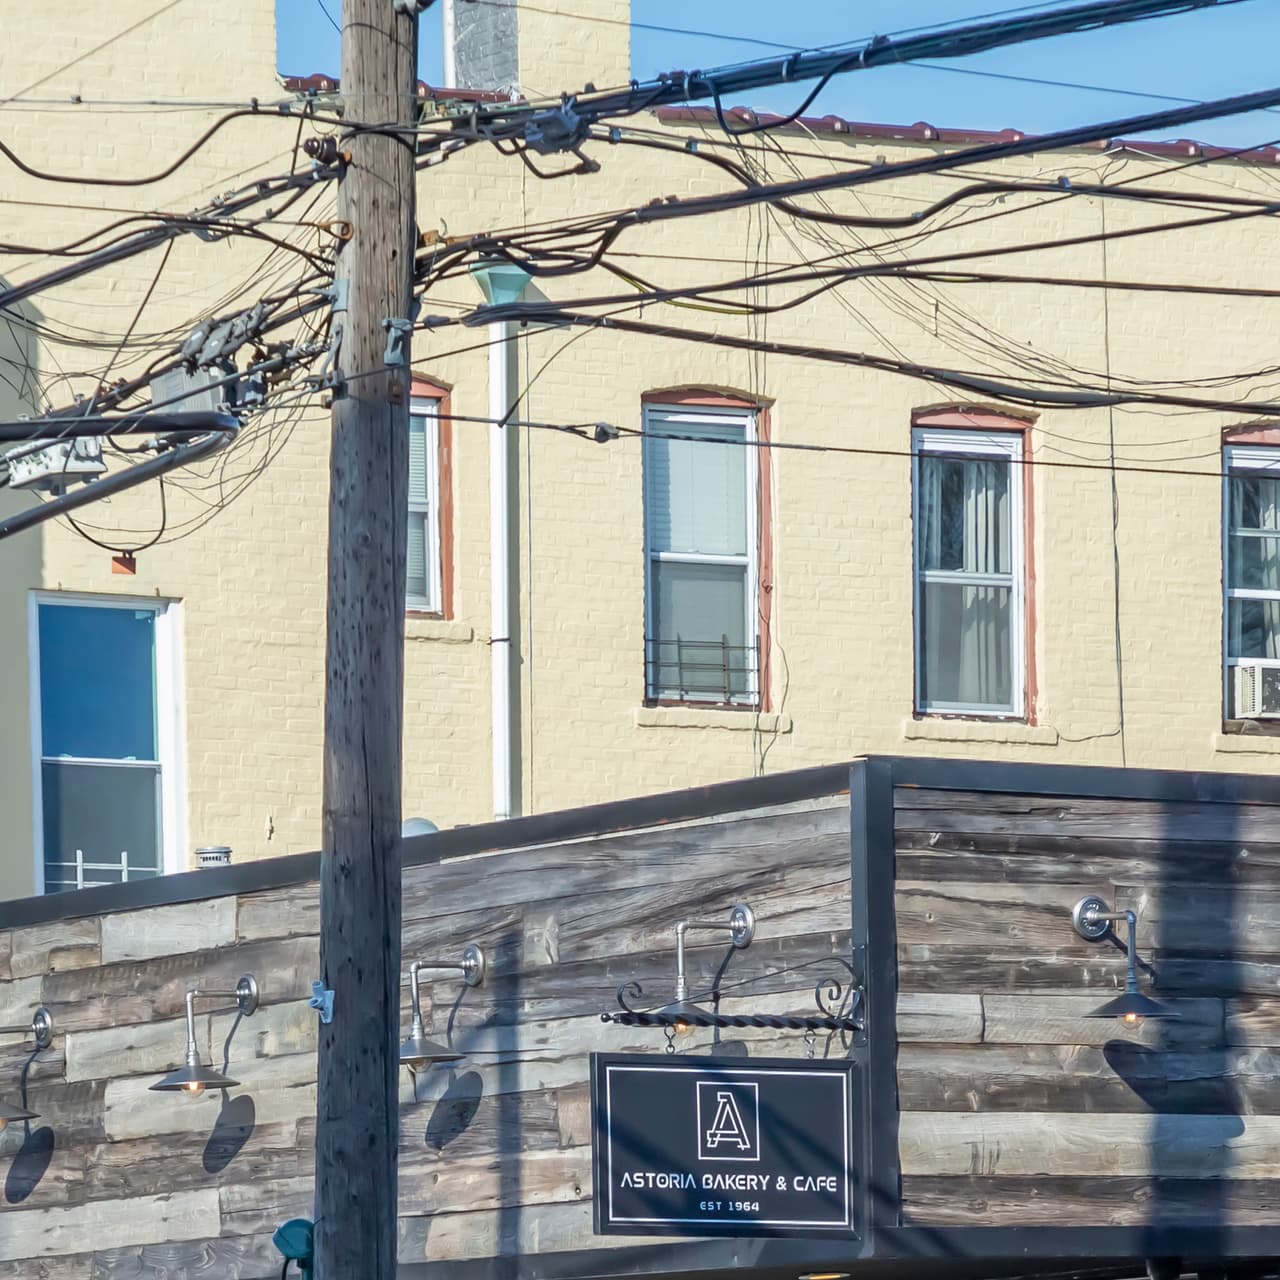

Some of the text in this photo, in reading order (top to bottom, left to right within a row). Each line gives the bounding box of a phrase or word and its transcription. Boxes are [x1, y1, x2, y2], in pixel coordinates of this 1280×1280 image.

[620, 1172, 837, 1192] ASTORIA BAKERY & CAFE
[700, 1201, 760, 1213] EST 1964
